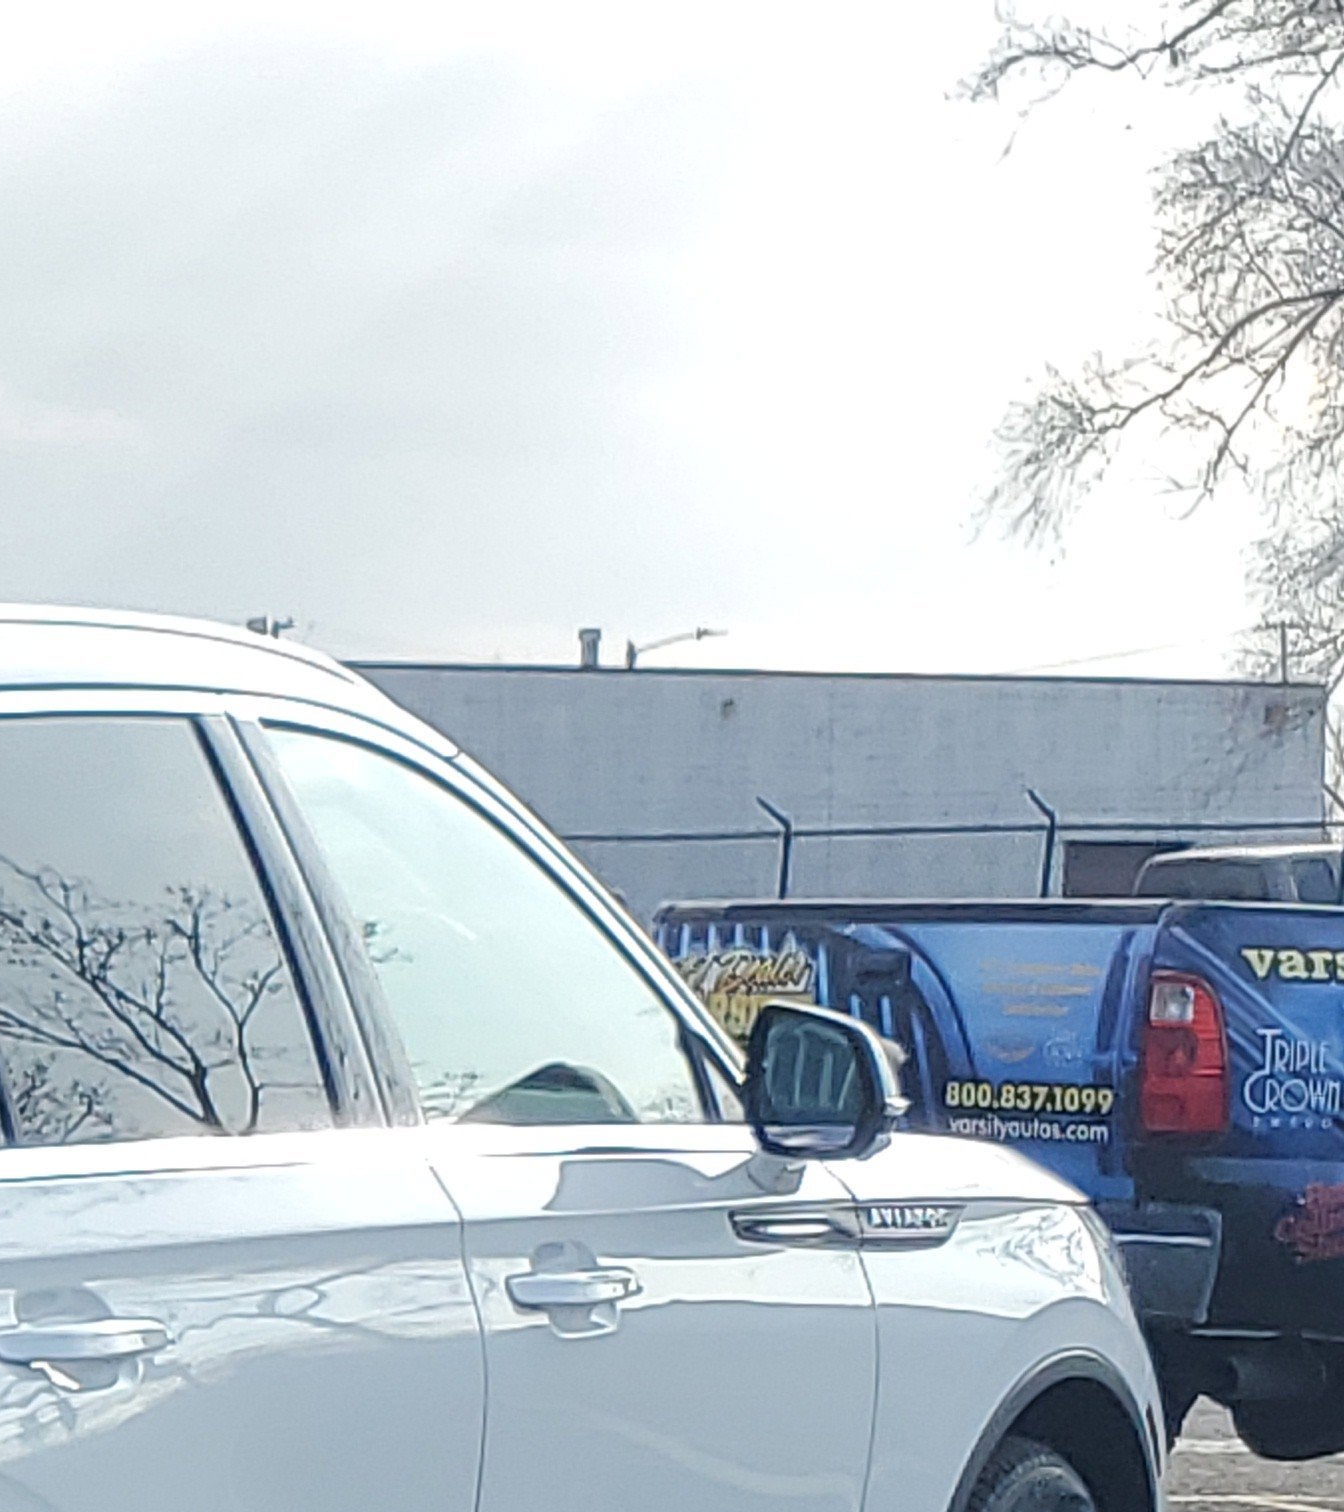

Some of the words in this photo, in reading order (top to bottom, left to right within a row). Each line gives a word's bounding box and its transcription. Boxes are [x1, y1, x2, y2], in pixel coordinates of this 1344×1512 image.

[1256, 1028, 1330, 1077] TRIPLE
[945, 1082, 1114, 1115] 800.837.1099
[1243, 1069, 1341, 1114] CROWN
[950, 1114, 1109, 1144] varsityautos.com
